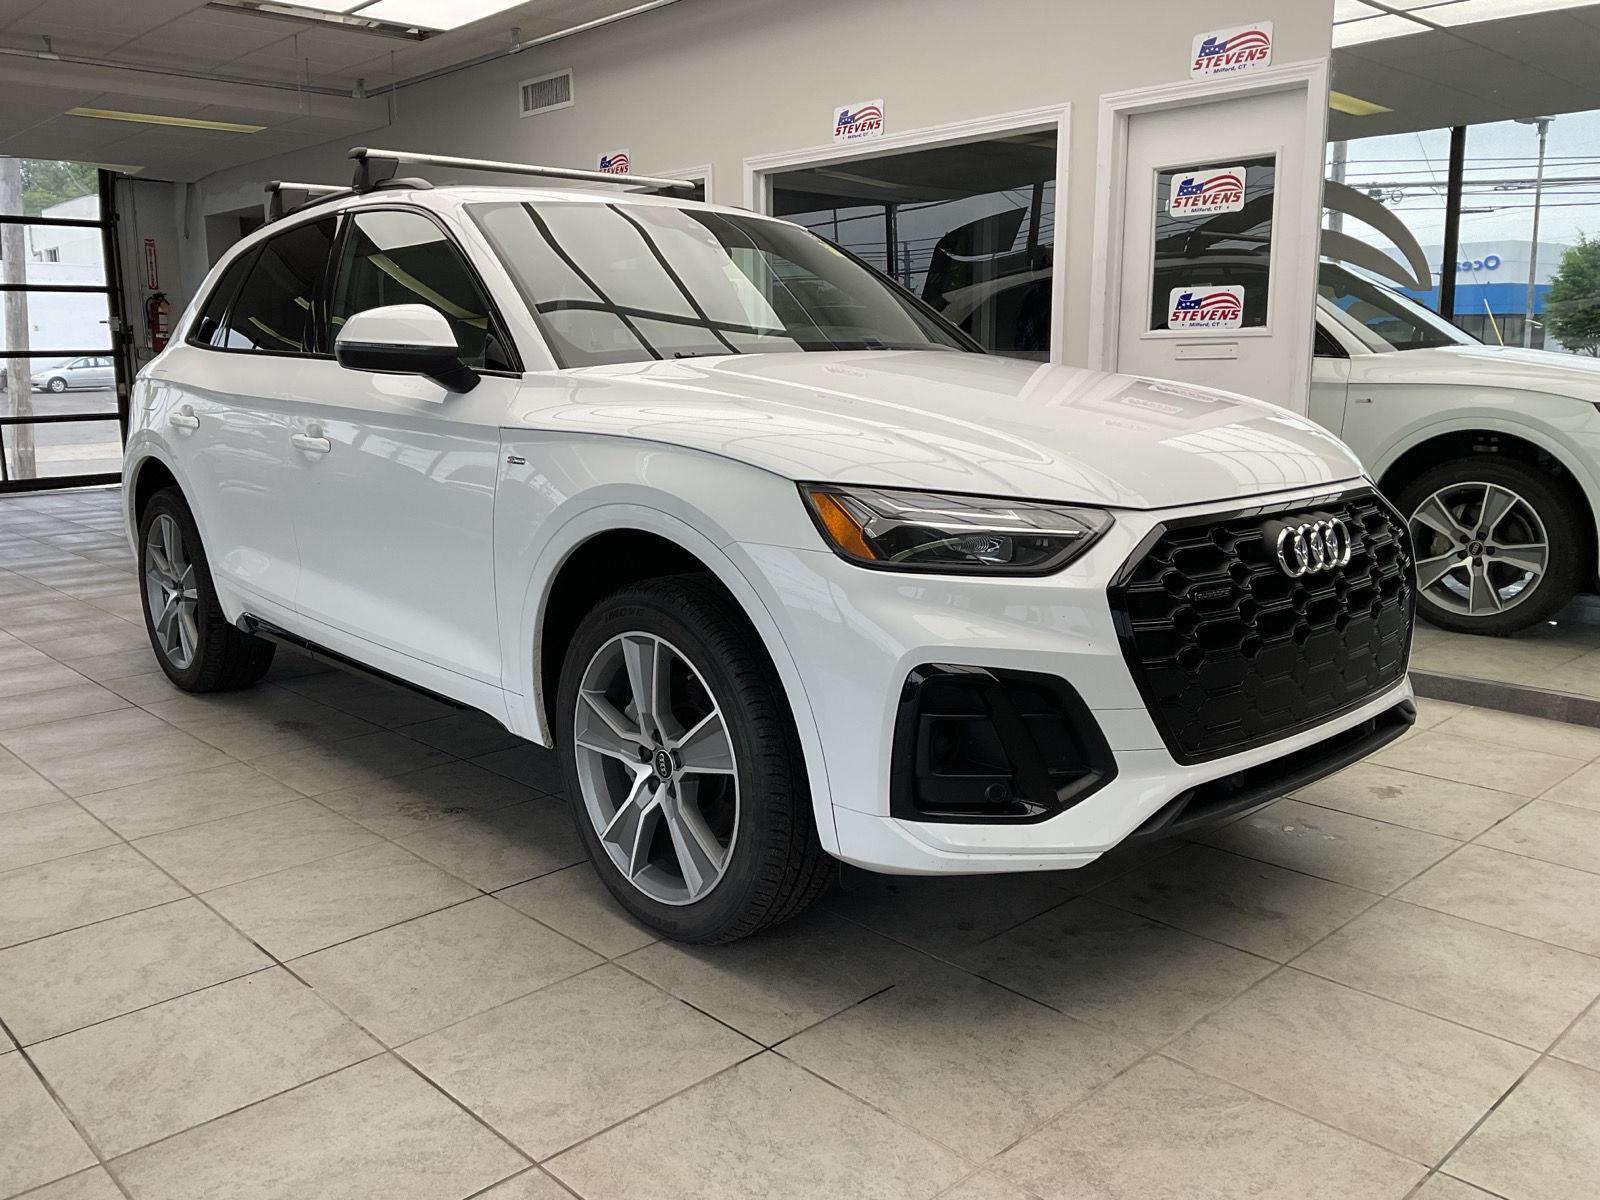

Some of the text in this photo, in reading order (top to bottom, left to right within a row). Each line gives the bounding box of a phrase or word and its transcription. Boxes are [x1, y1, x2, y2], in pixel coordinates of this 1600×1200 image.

[1193, 46, 1269, 71] STEVENS
[835, 119, 882, 136] STEVENS
[600, 165, 629, 174] EVENS
[1172, 191, 1243, 209] STEVENS
[1170, 309, 1241, 321] STEVENS
